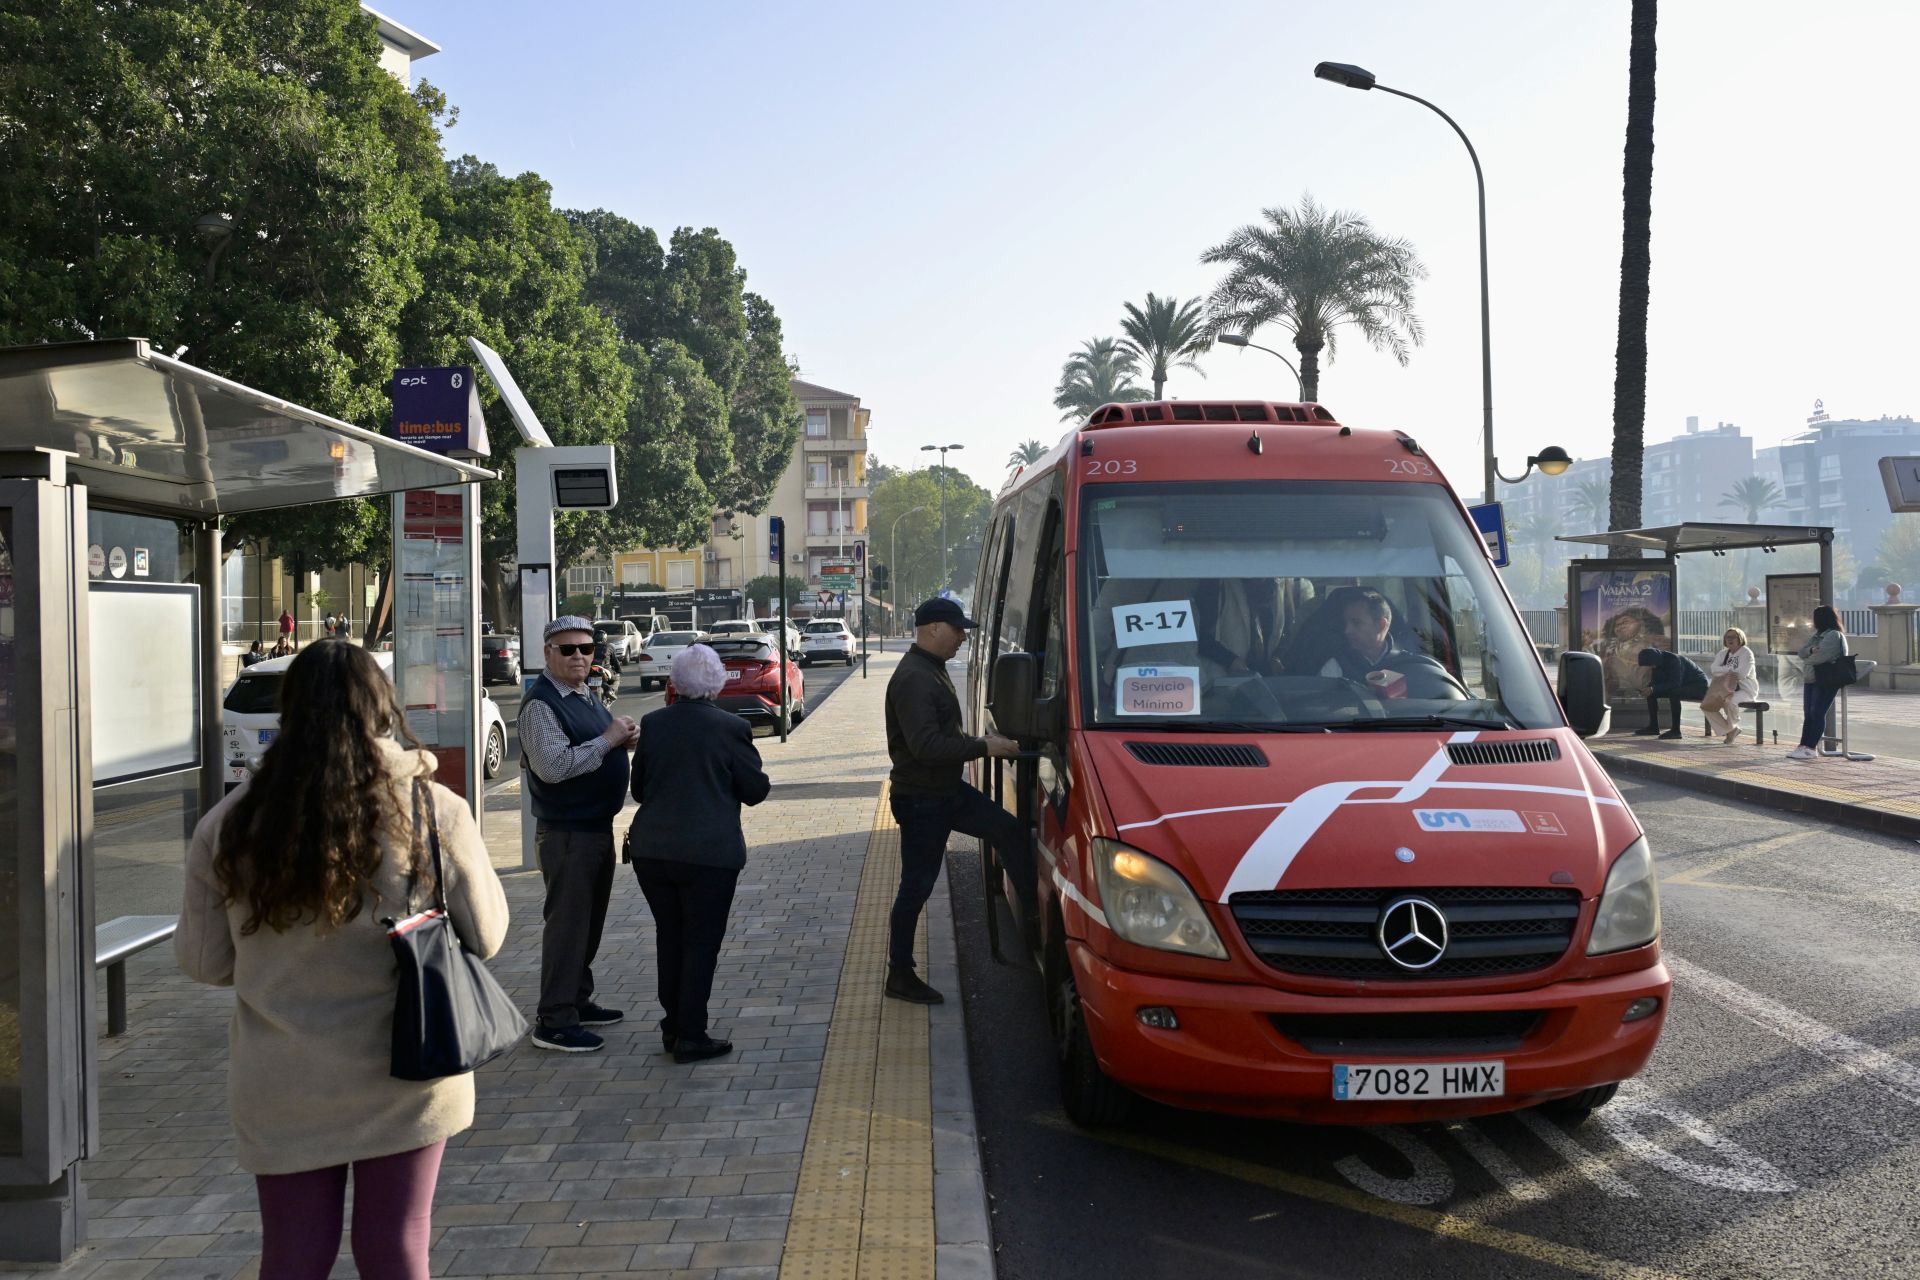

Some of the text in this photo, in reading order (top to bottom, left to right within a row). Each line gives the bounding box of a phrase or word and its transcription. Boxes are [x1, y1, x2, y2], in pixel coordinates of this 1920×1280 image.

[401, 376, 427, 386] ept
[400, 421, 462, 434] time:bus
[1087, 460, 1137, 475] 203
[1384, 459, 1433, 476] 203
[595, 587, 601, 596] P
[1641, 584, 1652, 596] 2
[1125, 611, 1187, 632] R-17
[1131, 681, 1185, 692] Servicio
[1133, 699, 1184, 710] Mínimo
[1338, 1066, 1496, 1095] E 7082 HMX
